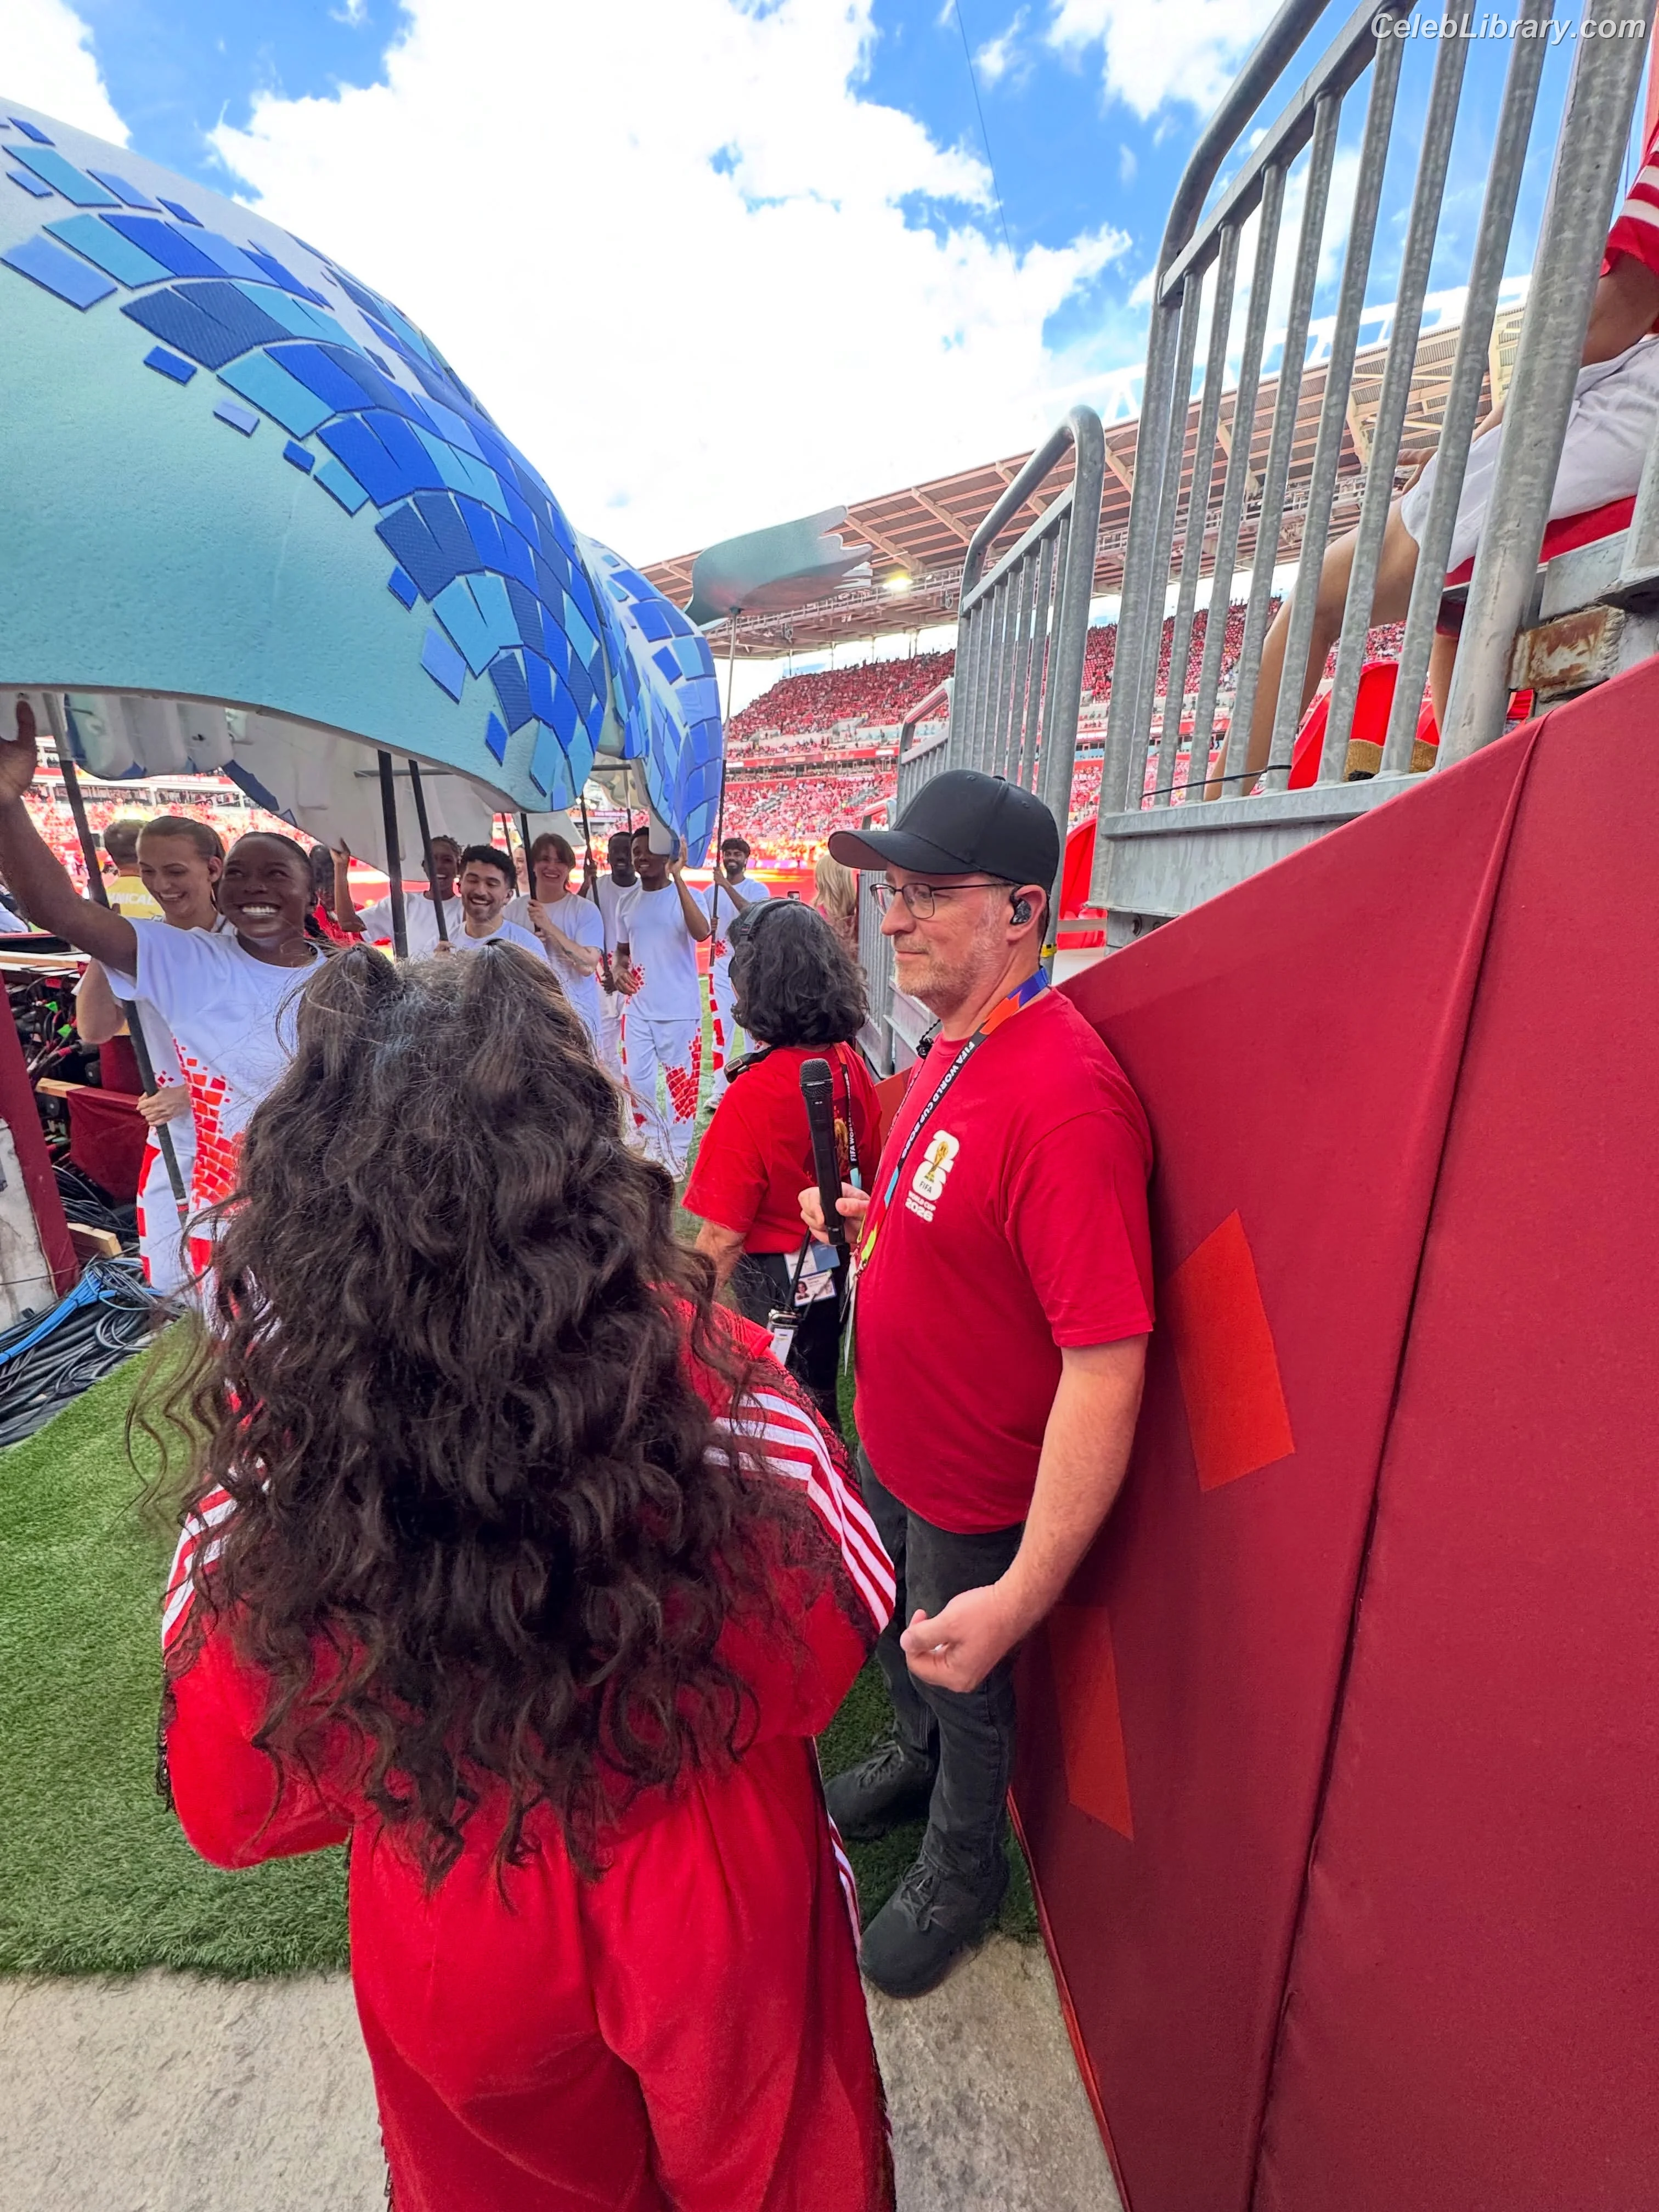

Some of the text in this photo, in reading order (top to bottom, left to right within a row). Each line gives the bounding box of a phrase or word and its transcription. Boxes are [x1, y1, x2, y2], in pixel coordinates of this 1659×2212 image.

[956, 1041, 975, 1064] FIFA
[933, 1065, 959, 1102] WORLD
[920, 1102, 933, 1123] CUP
[919, 1181, 932, 1194] FIFA
[905, 1198, 934, 1222] 2026
